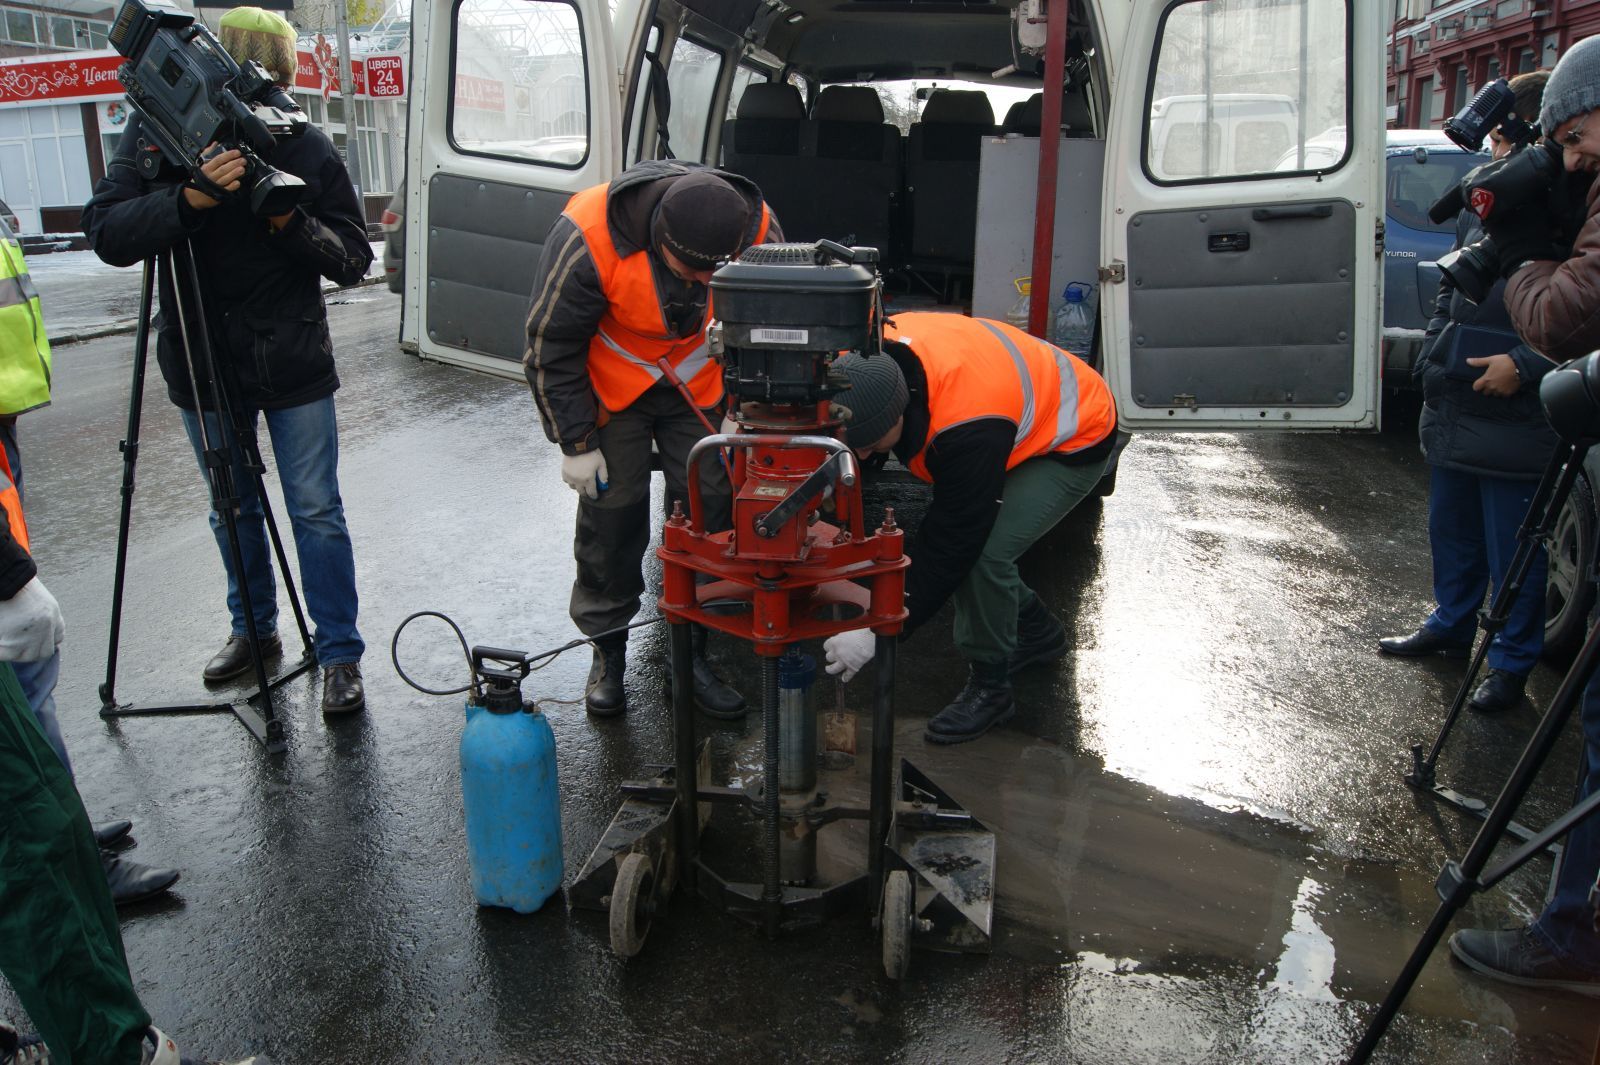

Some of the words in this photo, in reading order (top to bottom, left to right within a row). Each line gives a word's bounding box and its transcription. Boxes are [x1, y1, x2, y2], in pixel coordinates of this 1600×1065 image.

[368, 59, 400, 71] цветы
[82, 66, 118, 87] Цвет
[376, 70, 394, 85] 24
[373, 84, 400, 95] часа
[1385, 250, 1417, 258] YUNDAI
